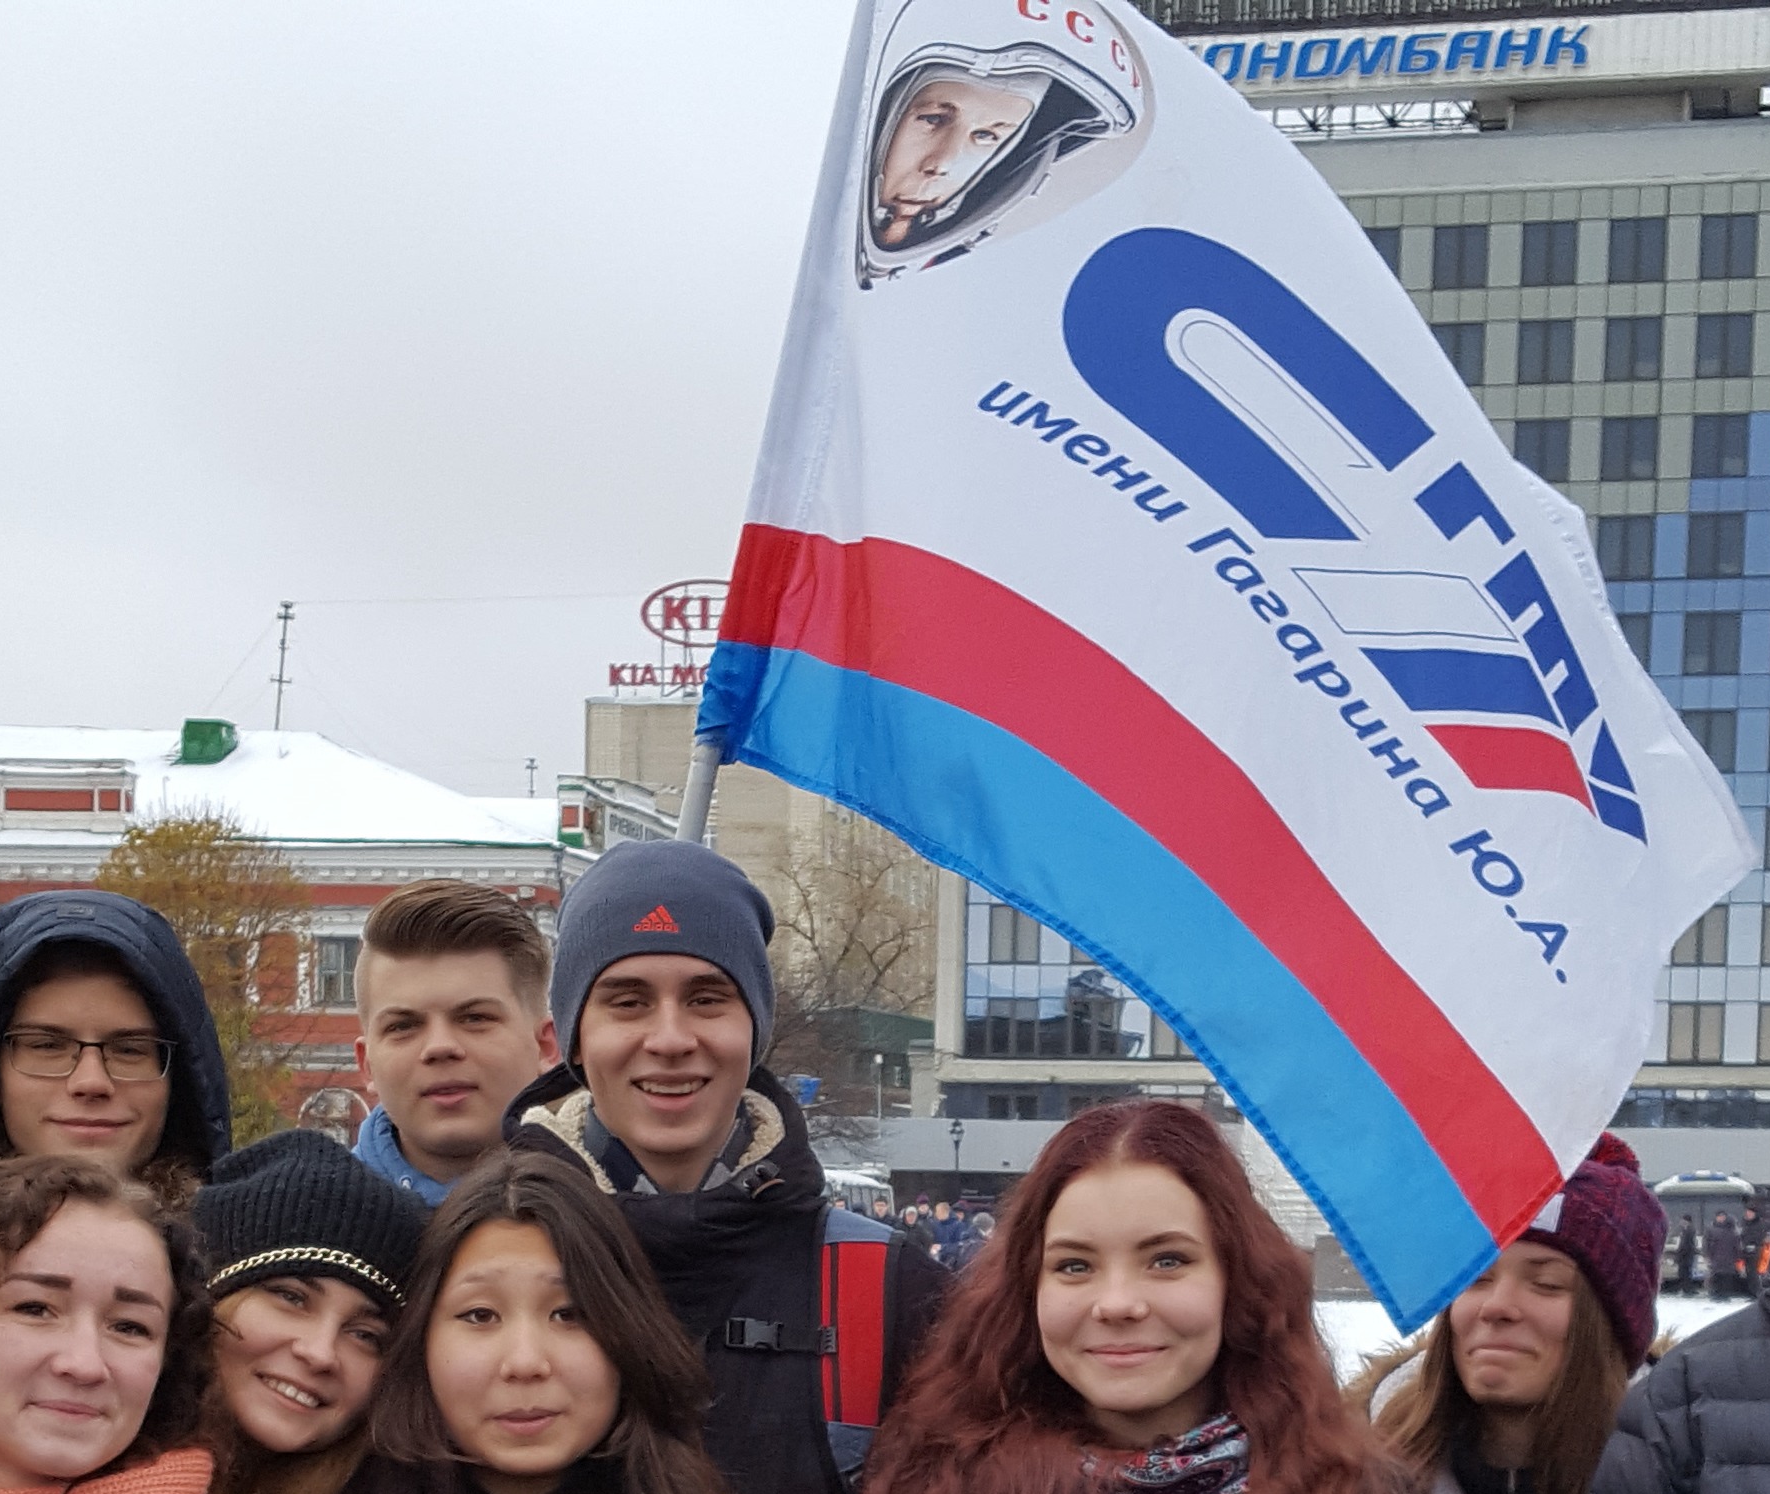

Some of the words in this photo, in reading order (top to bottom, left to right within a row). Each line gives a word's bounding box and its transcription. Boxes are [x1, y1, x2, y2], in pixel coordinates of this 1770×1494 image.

[1189, 25, 1590, 82] ОНОМБАНК
[662, 595, 711, 631] KI
[609, 663, 659, 686] KIA
[671, 663, 710, 686] M
[977, 380, 1190, 524] имени
[1186, 527, 1452, 819] Гагарина
[1448, 827, 1570, 985] Ю.А.
